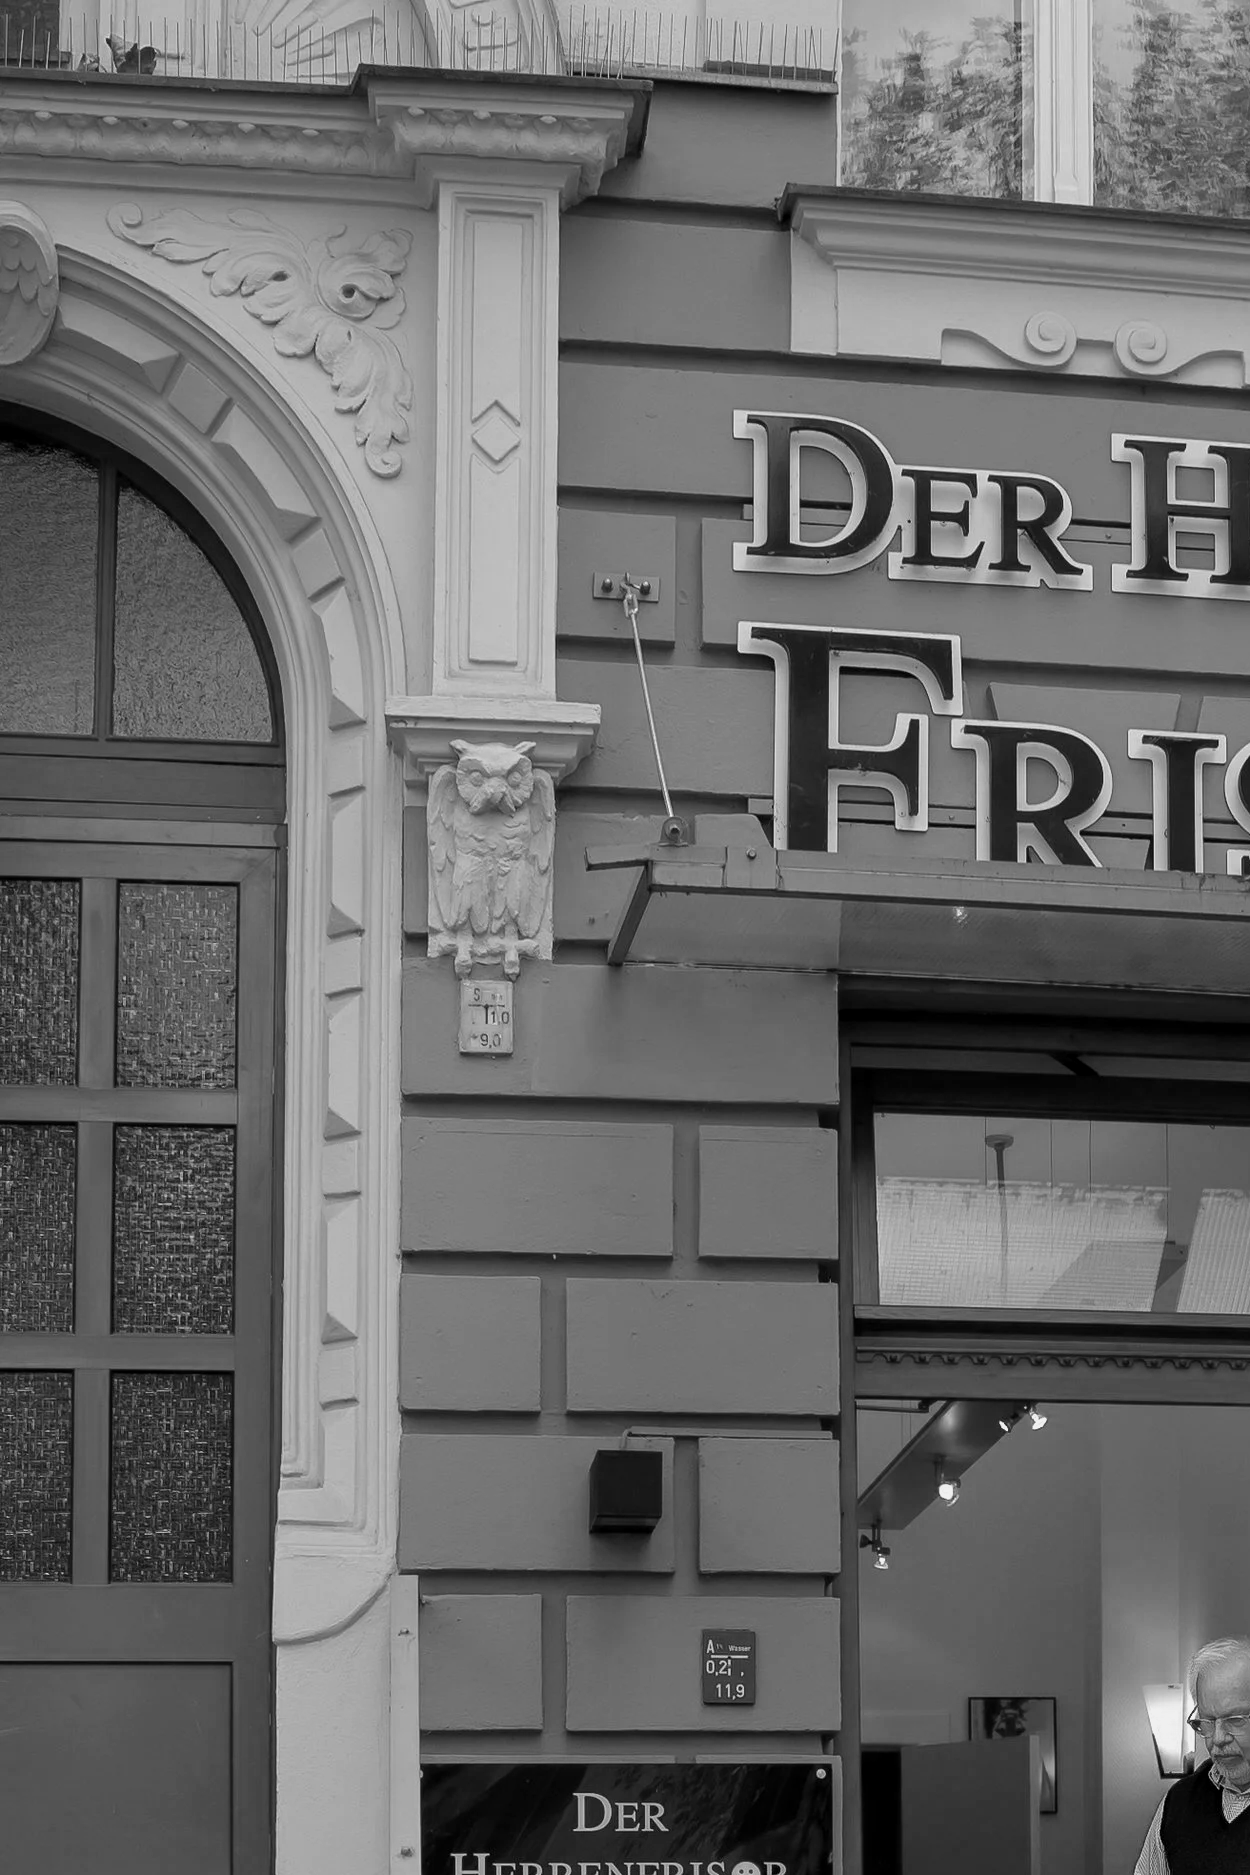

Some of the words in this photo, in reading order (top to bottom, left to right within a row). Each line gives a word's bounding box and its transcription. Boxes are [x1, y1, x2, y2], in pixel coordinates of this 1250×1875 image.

[733, 410, 1092, 592] DER
[706, 1639, 715, 1654] A
[728, 1644, 752, 1652] Wasser
[715, 1683, 745, 1700] 11,9
[572, 1792, 669, 1832] DER
